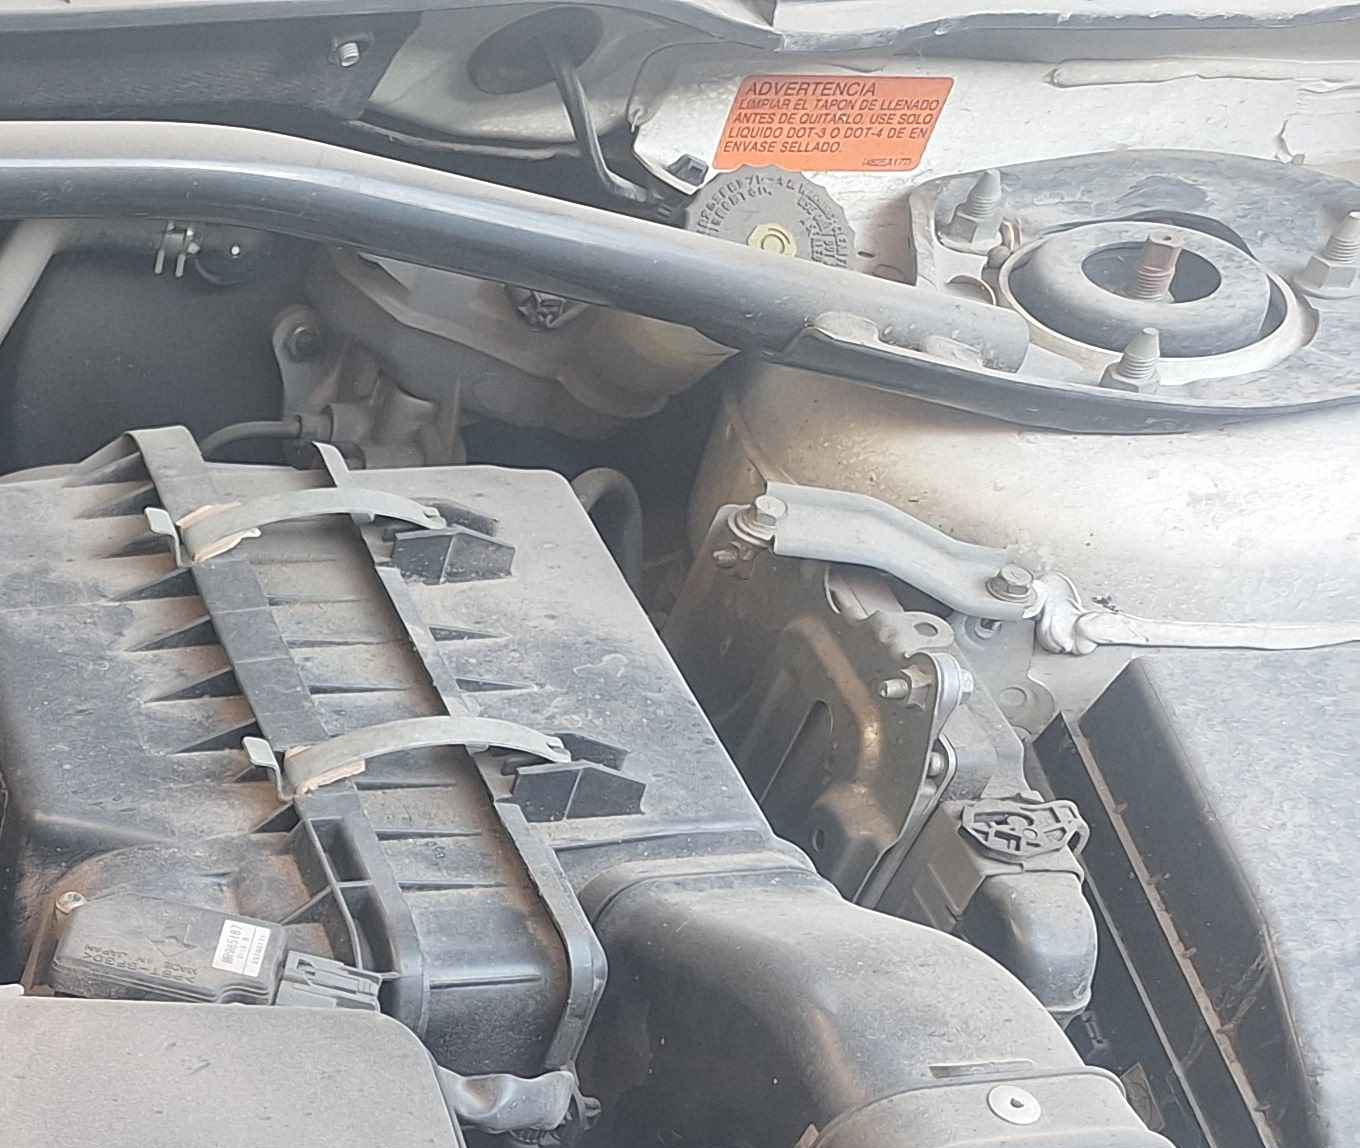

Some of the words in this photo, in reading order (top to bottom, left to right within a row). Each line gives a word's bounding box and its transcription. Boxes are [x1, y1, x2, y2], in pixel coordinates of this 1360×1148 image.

[745, 81, 876, 97] ADVERTENCIA
[738, 98, 791, 110] LIMPIAR
[793, 98, 808, 110] EL
[814, 98, 857, 110] TAPON
[859, 99, 878, 111] DE
[880, 99, 940, 111] LLENADO
[733, 112, 777, 124] ANTES
[778, 112, 798, 124] DE
[869, 113, 896, 125] USE
[898, 113, 934, 125] SOLO
[728, 126, 783, 139] LIQUIDO
[786, 126, 827, 139] DOT-3
[829, 127, 840, 139] O
[843, 127, 884, 139] DOT-4
[887, 127, 907, 139] DE
[909, 127, 928, 139] EN
[723, 140, 778, 153] ENVASE
[780, 141, 842, 153] SELLADO.
